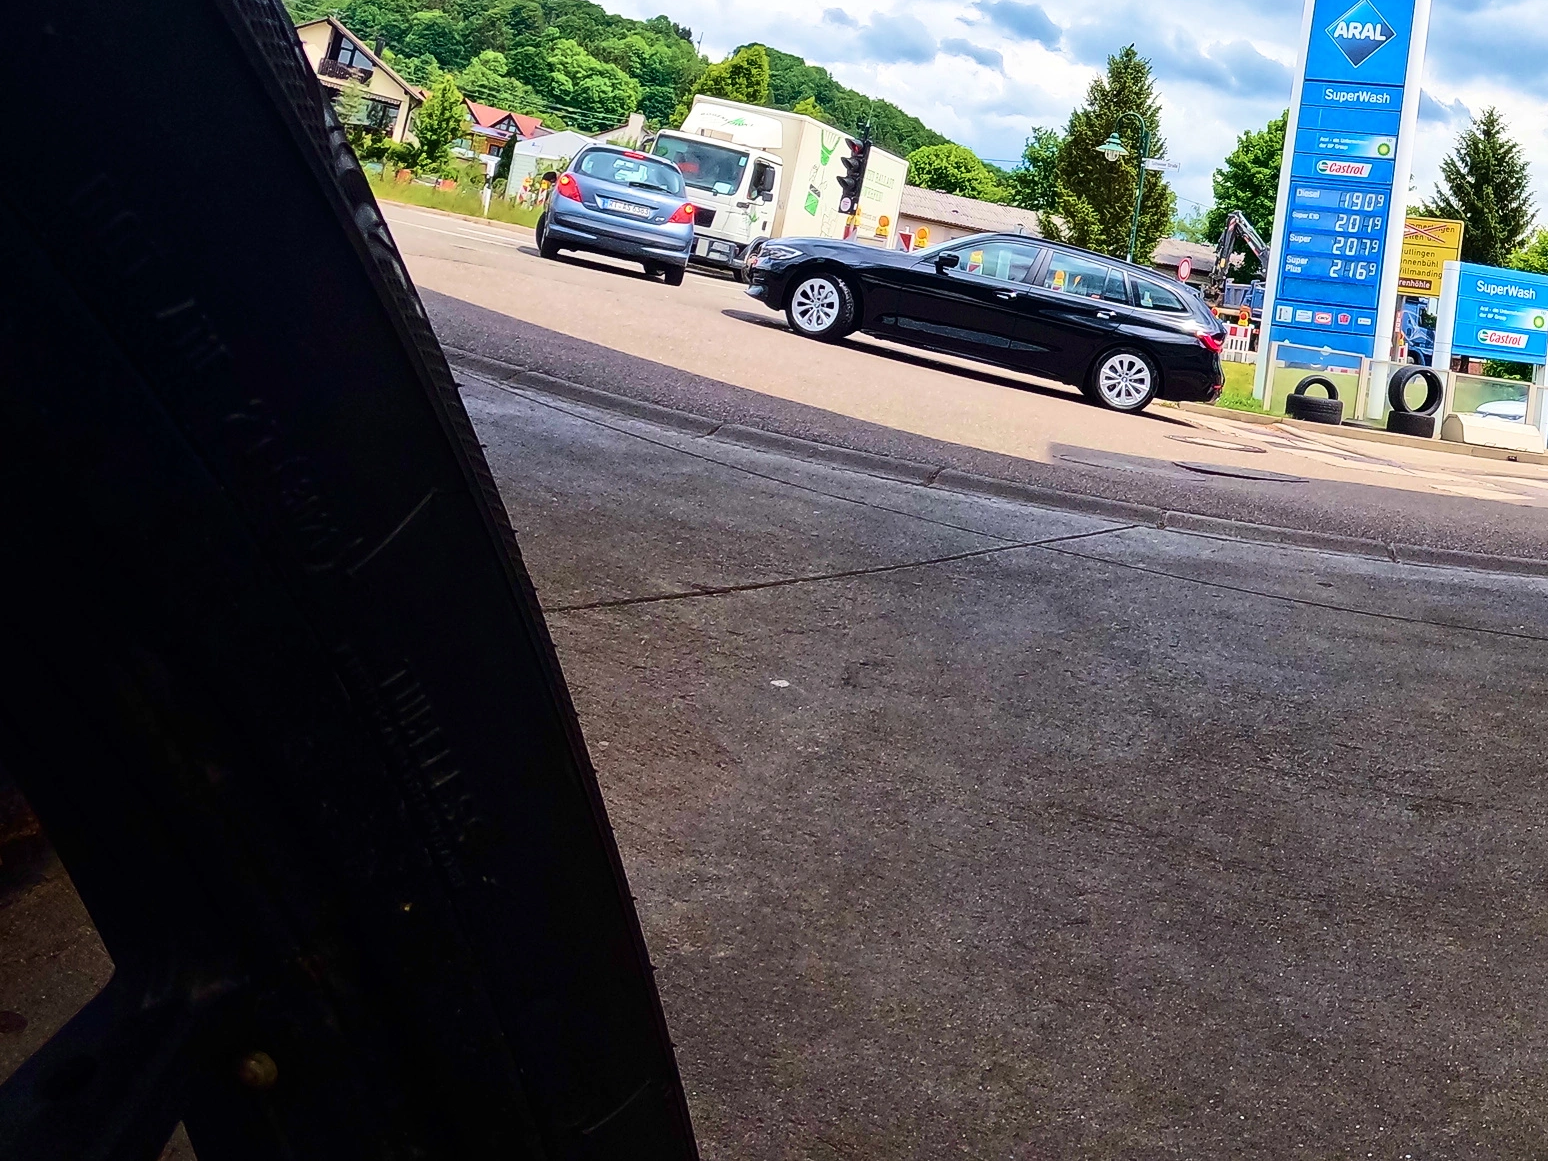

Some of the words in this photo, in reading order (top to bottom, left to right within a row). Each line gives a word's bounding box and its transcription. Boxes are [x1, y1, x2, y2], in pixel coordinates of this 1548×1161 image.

[1334, 21, 1387, 41] ARAL
[1325, 88, 1391, 104] SuperWash
[1329, 162, 1364, 175] Castrol
[1296, 189, 1320, 199] Diesel
[1292, 211, 1308, 220] Super
[1309, 213, 1320, 221] E10
[1289, 233, 1312, 244] Super
[1401, 248, 1436, 258] utlingen
[1286, 255, 1308, 265] Super
[1285, 264, 1302, 273] Plus
[1398, 279, 1431, 289] renhöhle
[1476, 280, 1536, 300] SuperWash
[1489, 332, 1522, 346] Castrol
